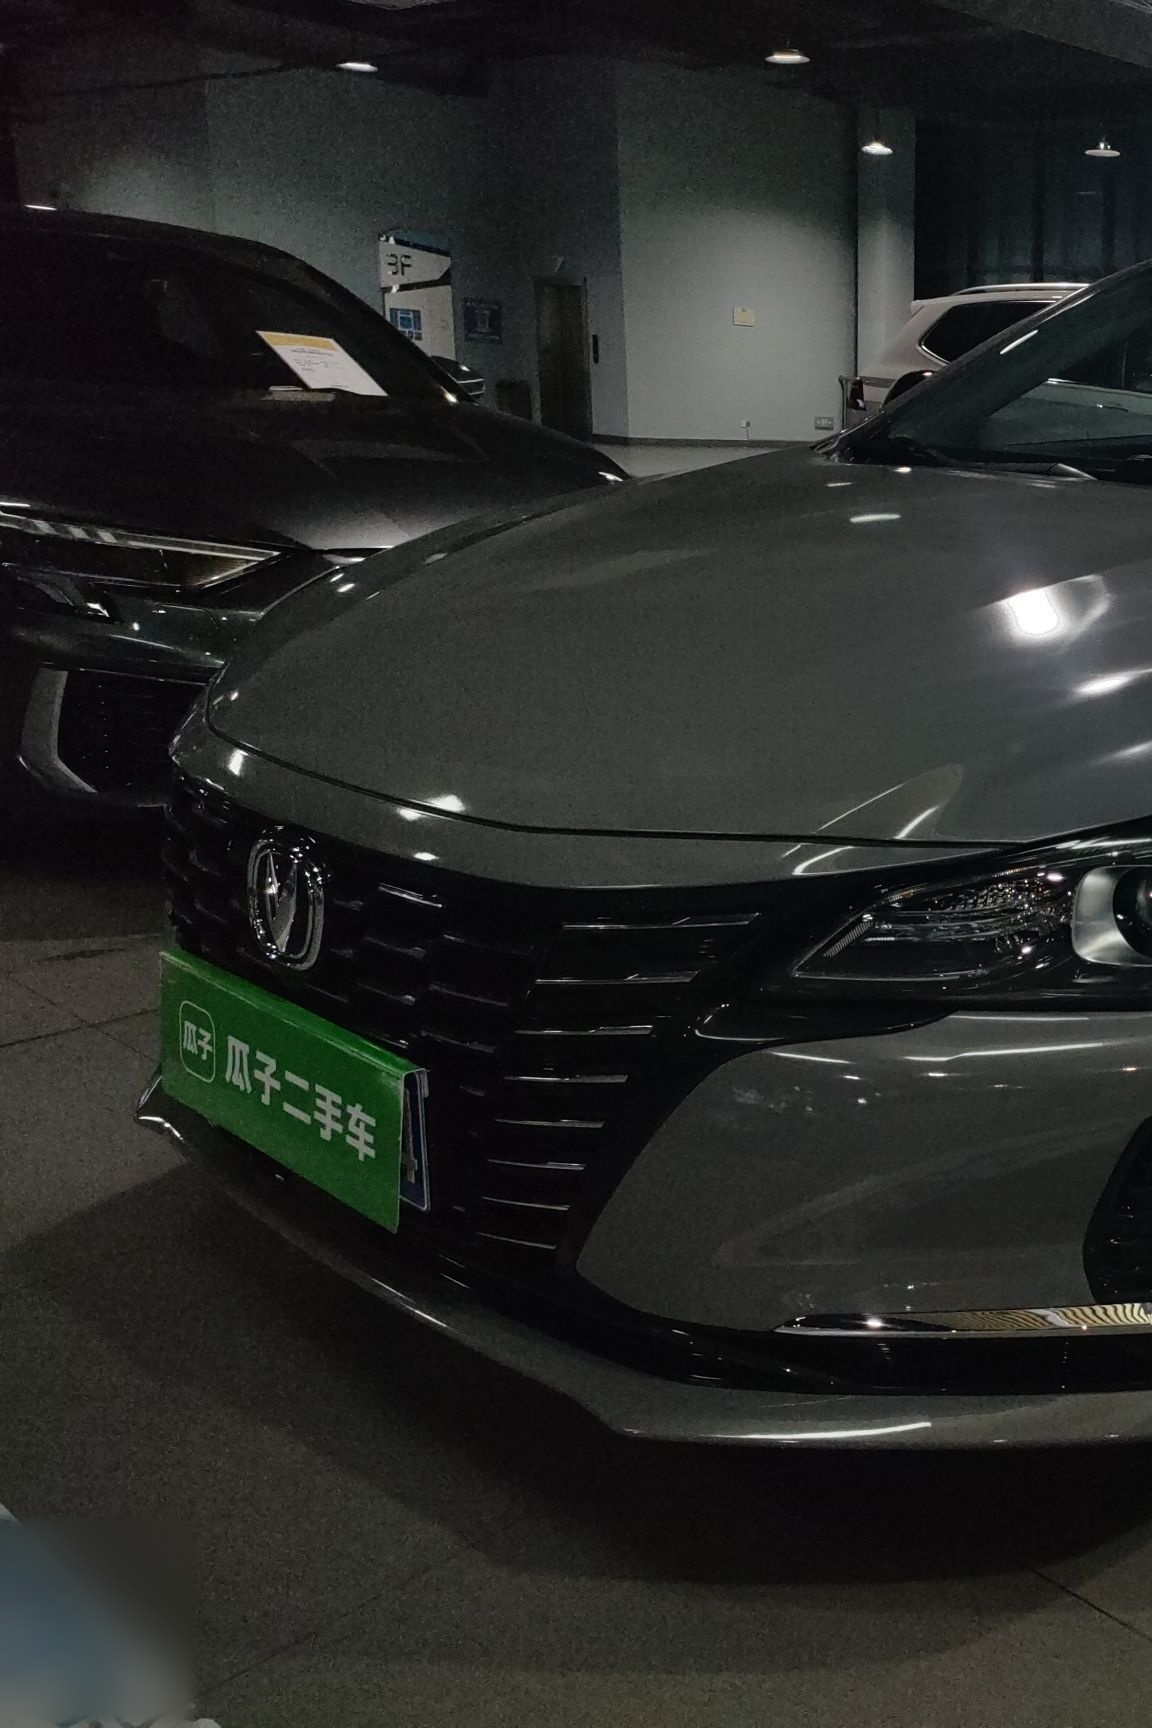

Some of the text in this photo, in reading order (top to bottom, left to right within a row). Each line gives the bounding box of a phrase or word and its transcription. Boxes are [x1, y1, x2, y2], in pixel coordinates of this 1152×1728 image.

[183, 1020, 213, 1061] 瓜子
[225, 1034, 376, 1161] 瓜子二手车
